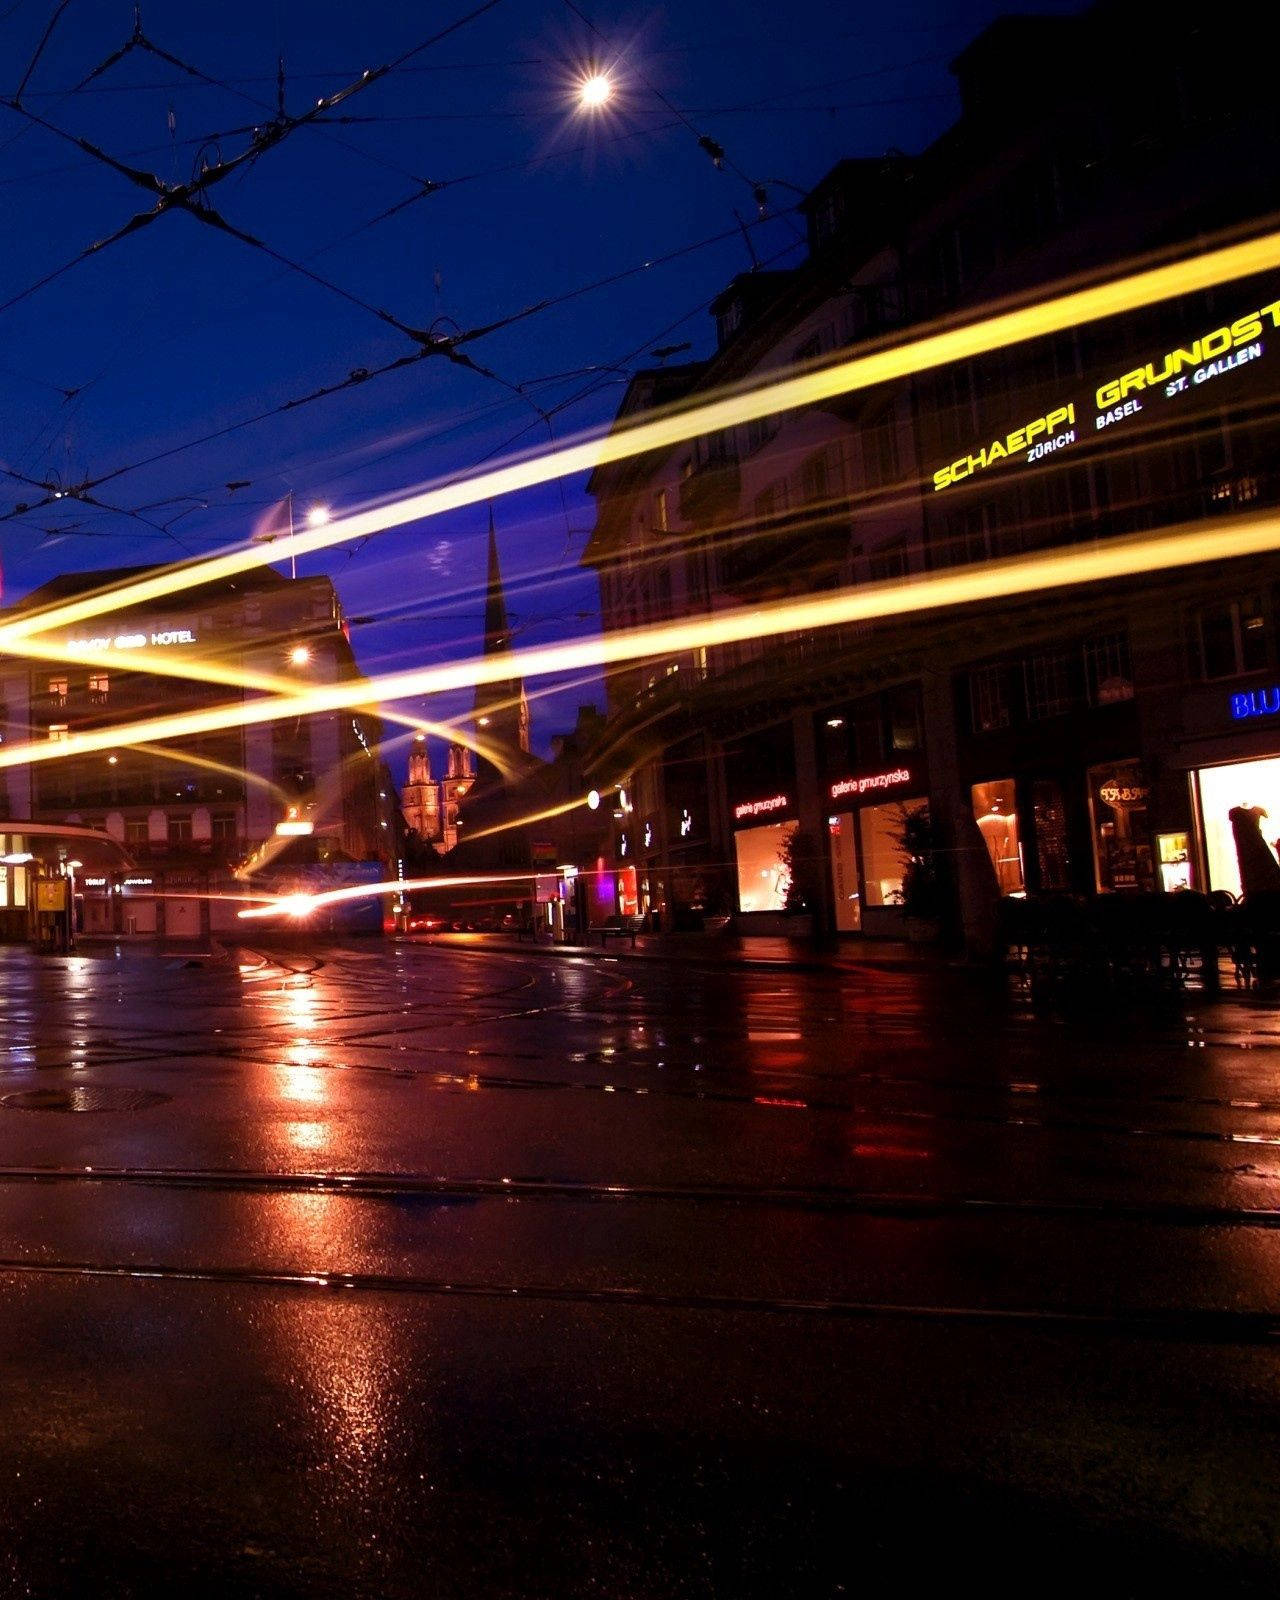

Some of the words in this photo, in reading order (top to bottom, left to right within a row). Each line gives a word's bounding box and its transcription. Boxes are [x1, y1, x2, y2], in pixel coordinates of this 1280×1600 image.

[1027, 430, 1075, 463] ZÜRICH
[1096, 398, 1143, 430] BASEL
[1165, 378, 1189, 398] ST.
[1194, 342, 1262, 383] GALLEN
[932, 404, 1076, 490] SCHAEPPI
[151, 630, 197, 645] HOTEL
[831, 779, 858, 798] galerie
[858, 768, 910, 793] gmurzynska
